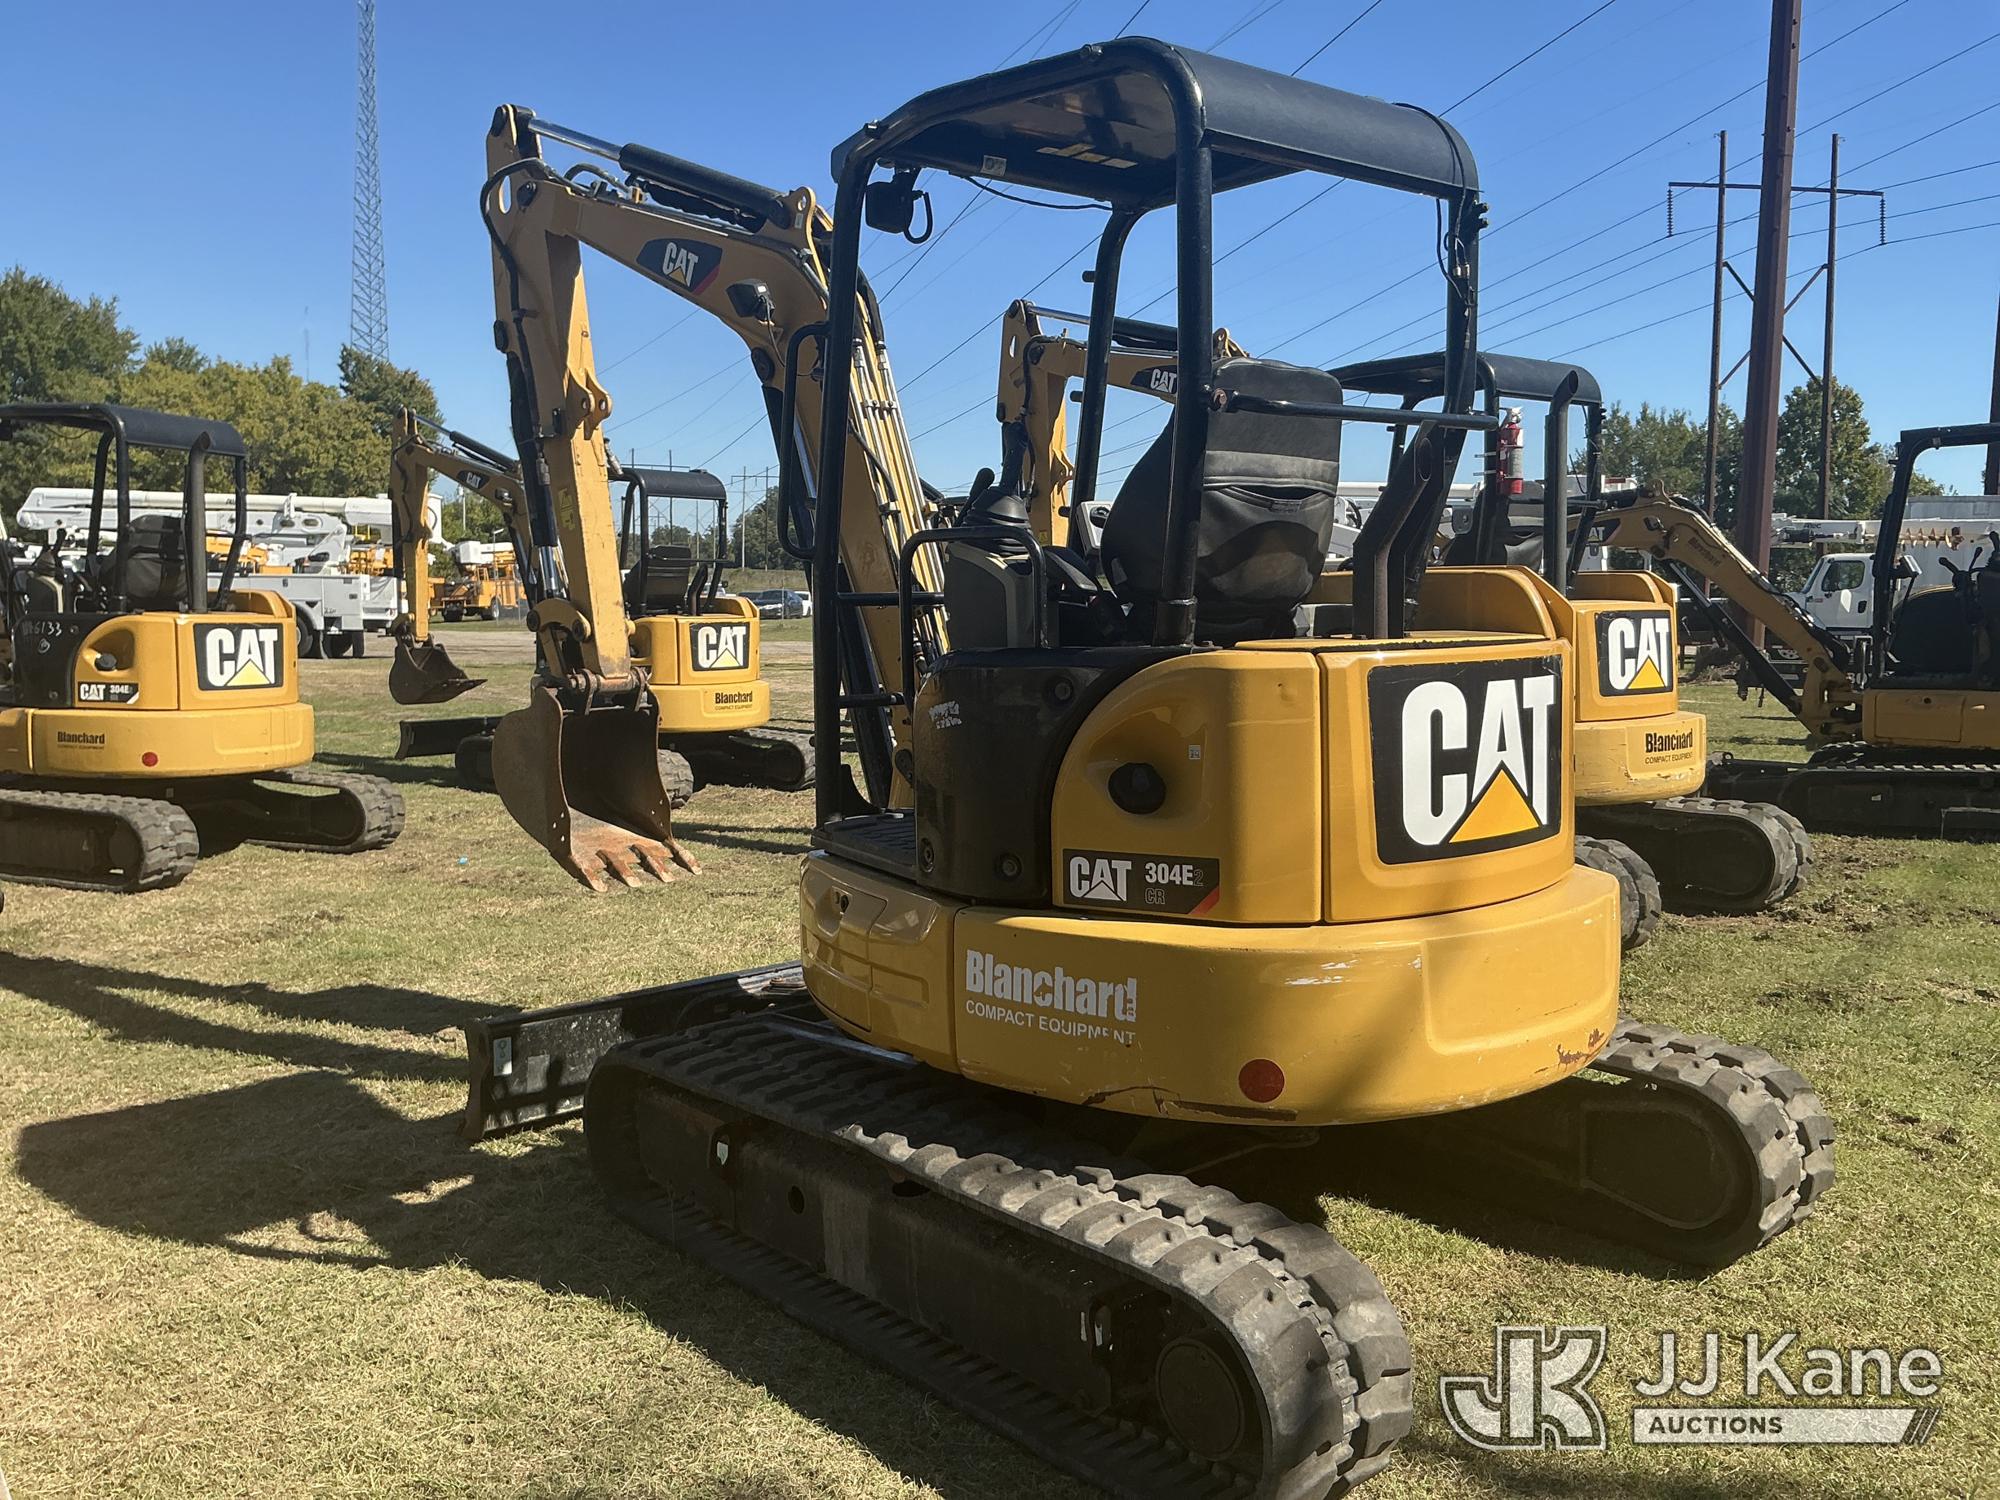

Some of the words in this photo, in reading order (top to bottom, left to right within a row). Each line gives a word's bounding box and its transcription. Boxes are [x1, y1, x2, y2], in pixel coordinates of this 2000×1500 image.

[662, 242, 699, 287] CAT
[1150, 368, 1177, 393] CAT
[466, 471, 482, 489] CAT
[1587, 526, 1606, 542] AT
[206, 628, 278, 687] CAT
[697, 626, 747, 669] CAT
[1608, 617, 1670, 691] CAT
[80, 683, 106, 701] CAT
[715, 691, 753, 704] Blanchard
[57, 731, 105, 745] Blanchard
[1645, 728, 1693, 753] Blanchard
[1402, 674, 1554, 846] CAT
[1069, 856, 1132, 902] CAT
[1145, 888, 1166, 905] CR
[966, 949, 1137, 1022] Blanchard
[966, 1000, 1035, 1027] COMPACT
